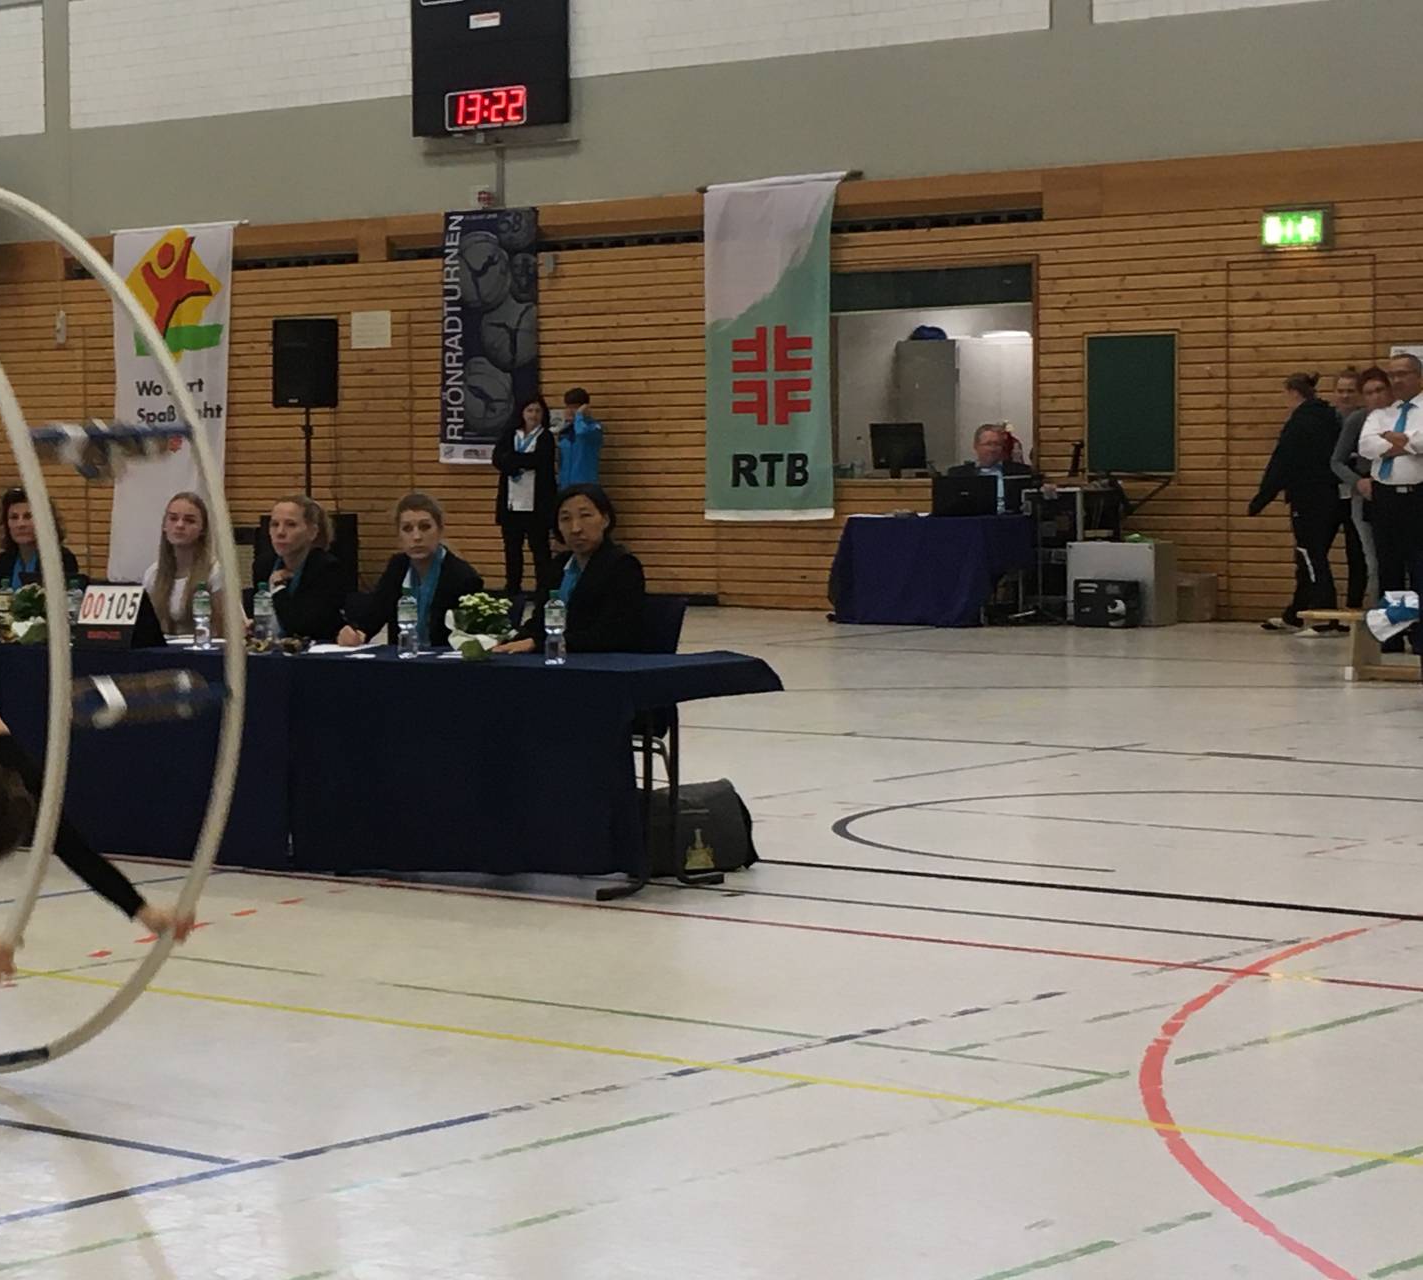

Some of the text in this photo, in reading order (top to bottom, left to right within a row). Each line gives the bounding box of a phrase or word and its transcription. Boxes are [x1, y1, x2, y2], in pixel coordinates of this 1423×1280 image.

[457, 90, 524, 125] 13:22
[443, 215, 465, 441] RHÖNRADTURNEN
[136, 380, 163, 396] Wo
[137, 404, 177, 424] Spaß
[731, 452, 810, 488] RTB
[81, 592, 139, 620] 00105
